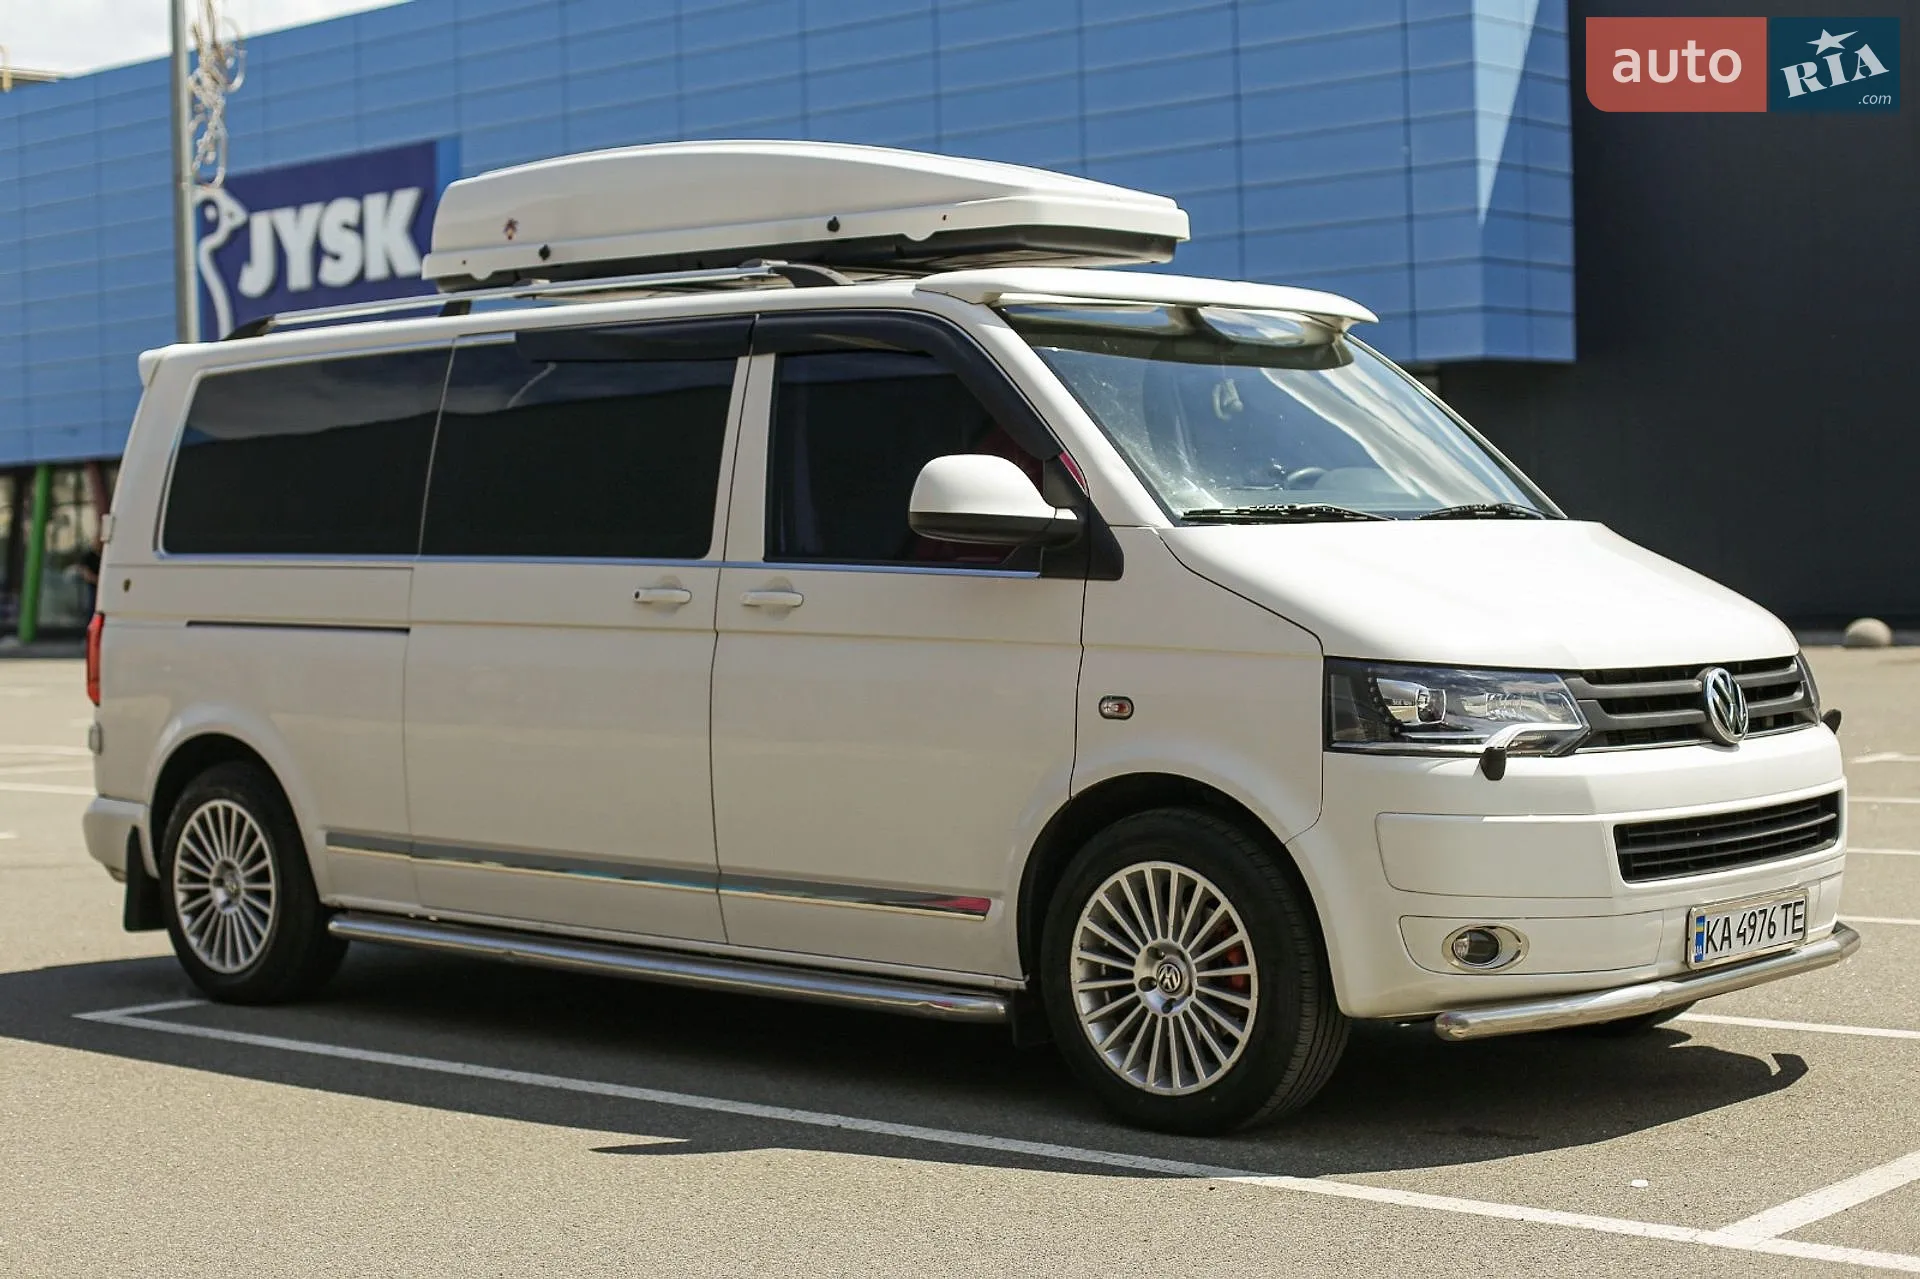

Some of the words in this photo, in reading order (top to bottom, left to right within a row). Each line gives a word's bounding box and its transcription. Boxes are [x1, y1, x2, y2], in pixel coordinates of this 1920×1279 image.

[237, 186, 422, 298] JYSK
[1705, 916, 1732, 954] KA
[1736, 905, 1777, 946] 4976
[1781, 900, 1805, 936] TE
